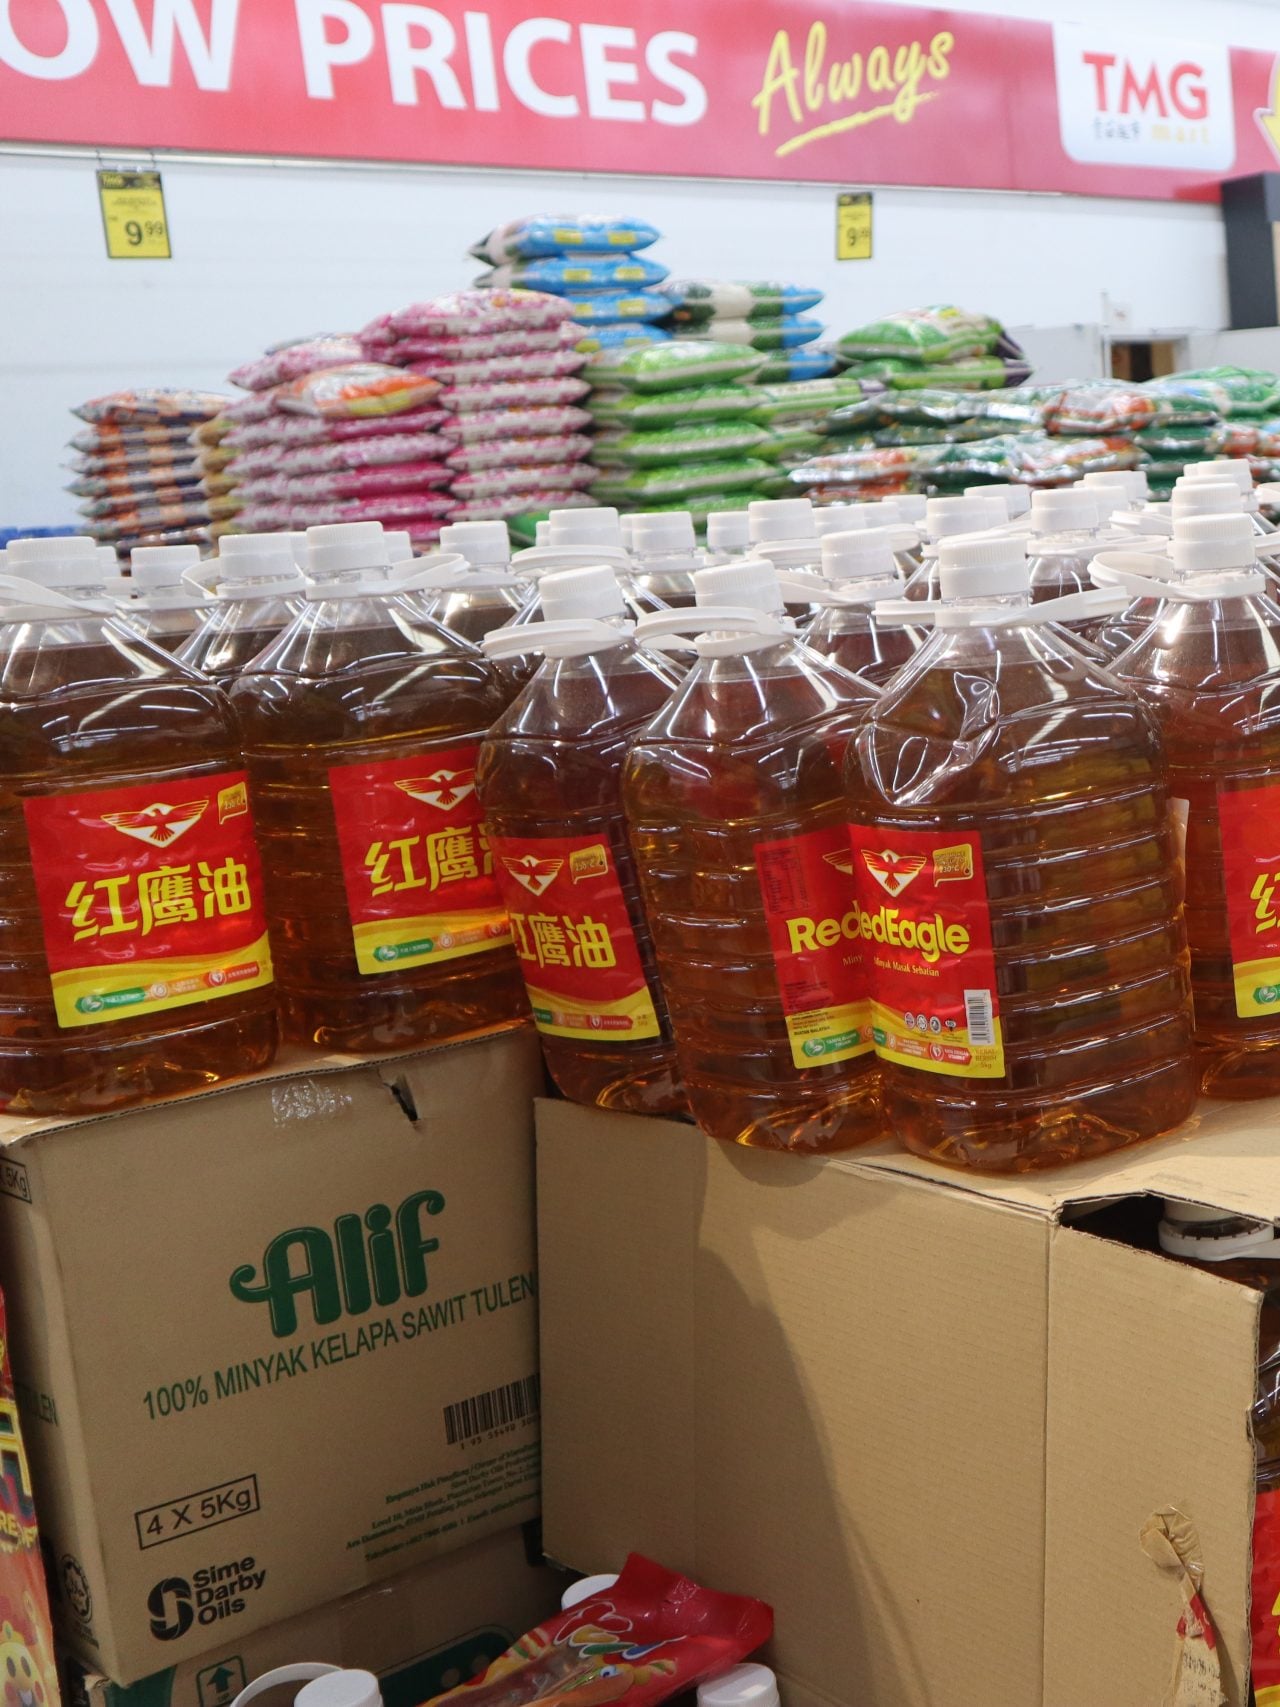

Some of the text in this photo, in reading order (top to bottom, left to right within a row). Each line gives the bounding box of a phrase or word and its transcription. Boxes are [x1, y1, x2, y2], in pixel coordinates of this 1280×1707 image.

[296, 0, 709, 126] PRICES
[752, 21, 954, 136] Always
[1083, 50, 1209, 120] TMG
[65, 857, 252, 942] 红鹰油
[860, 905, 970, 963] edEagle
[892, 960, 911, 974] Masak
[911, 965, 940, 977] Sebatian
[229, 1189, 446, 1338] Alif
[143, 1270, 537, 1420] 100% MINYAK KELAPA SAWIT TULEN
[147, 1489, 251, 1535] 4 X 5Kg
[193, 1556, 256, 1588] Sime
[195, 1569, 267, 1608] Darby
[198, 1598, 246, 1626] Oils
